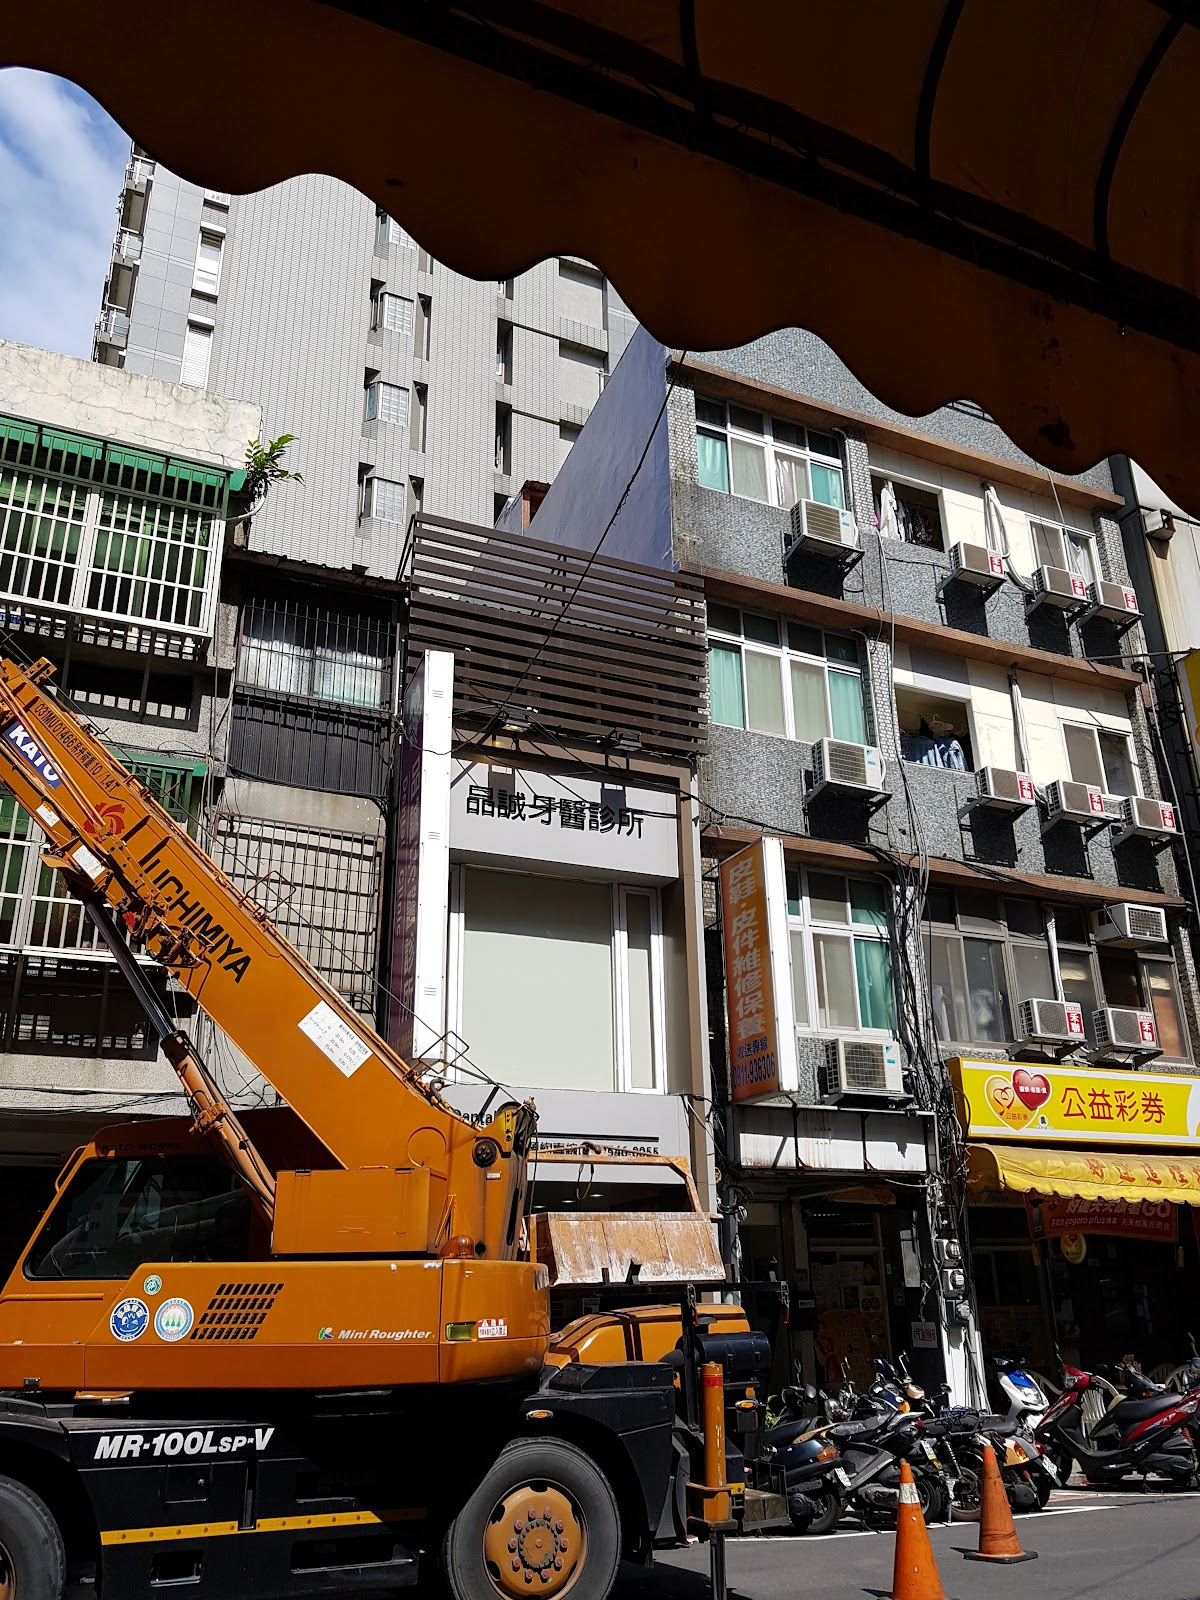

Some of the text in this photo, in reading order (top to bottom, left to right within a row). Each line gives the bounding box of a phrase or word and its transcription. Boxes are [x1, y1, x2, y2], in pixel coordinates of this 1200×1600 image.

[466, 784, 645, 840] 品誠牙醫診所
[1061, 1086, 1166, 1124] 公益彩券
[338, 1329, 432, 1341] Mini Roughter
